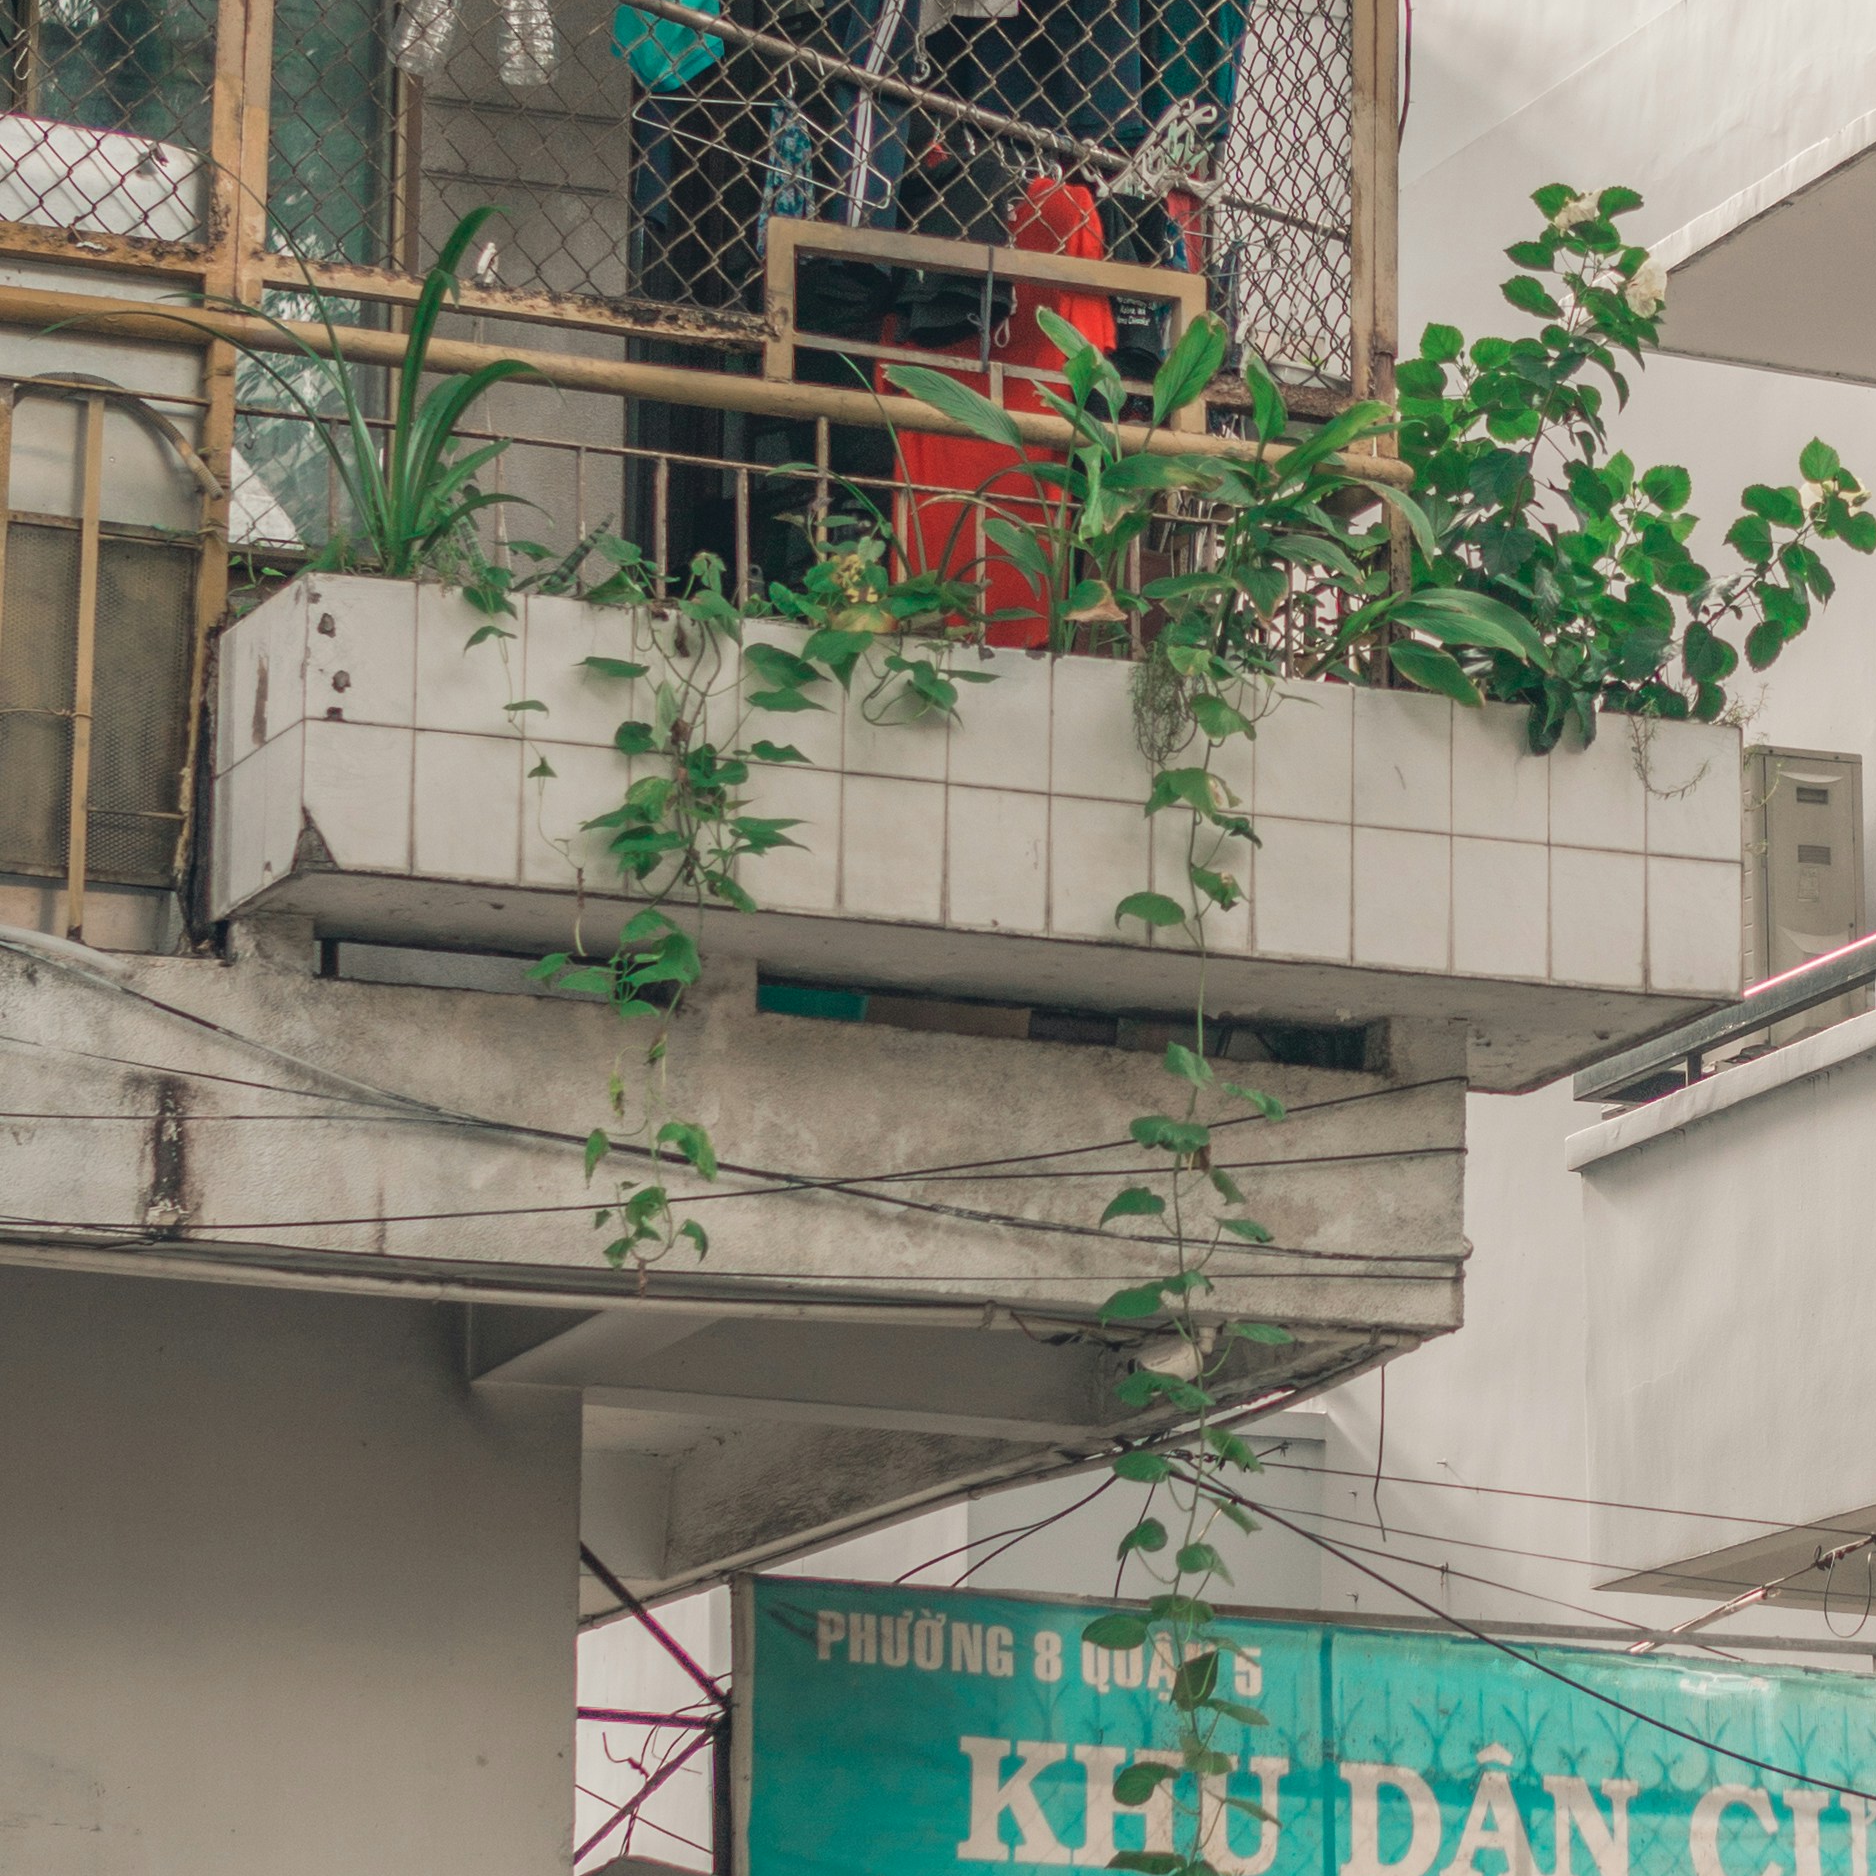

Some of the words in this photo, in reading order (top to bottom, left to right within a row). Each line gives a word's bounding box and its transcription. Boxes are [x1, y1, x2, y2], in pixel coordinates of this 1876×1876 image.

[817, 1608, 1015, 1678] PHƯỜNG
[1034, 1631, 1062, 1683] 8
[1234, 1647, 1262, 1698] 5
[956, 1735, 1290, 1876] KHU
